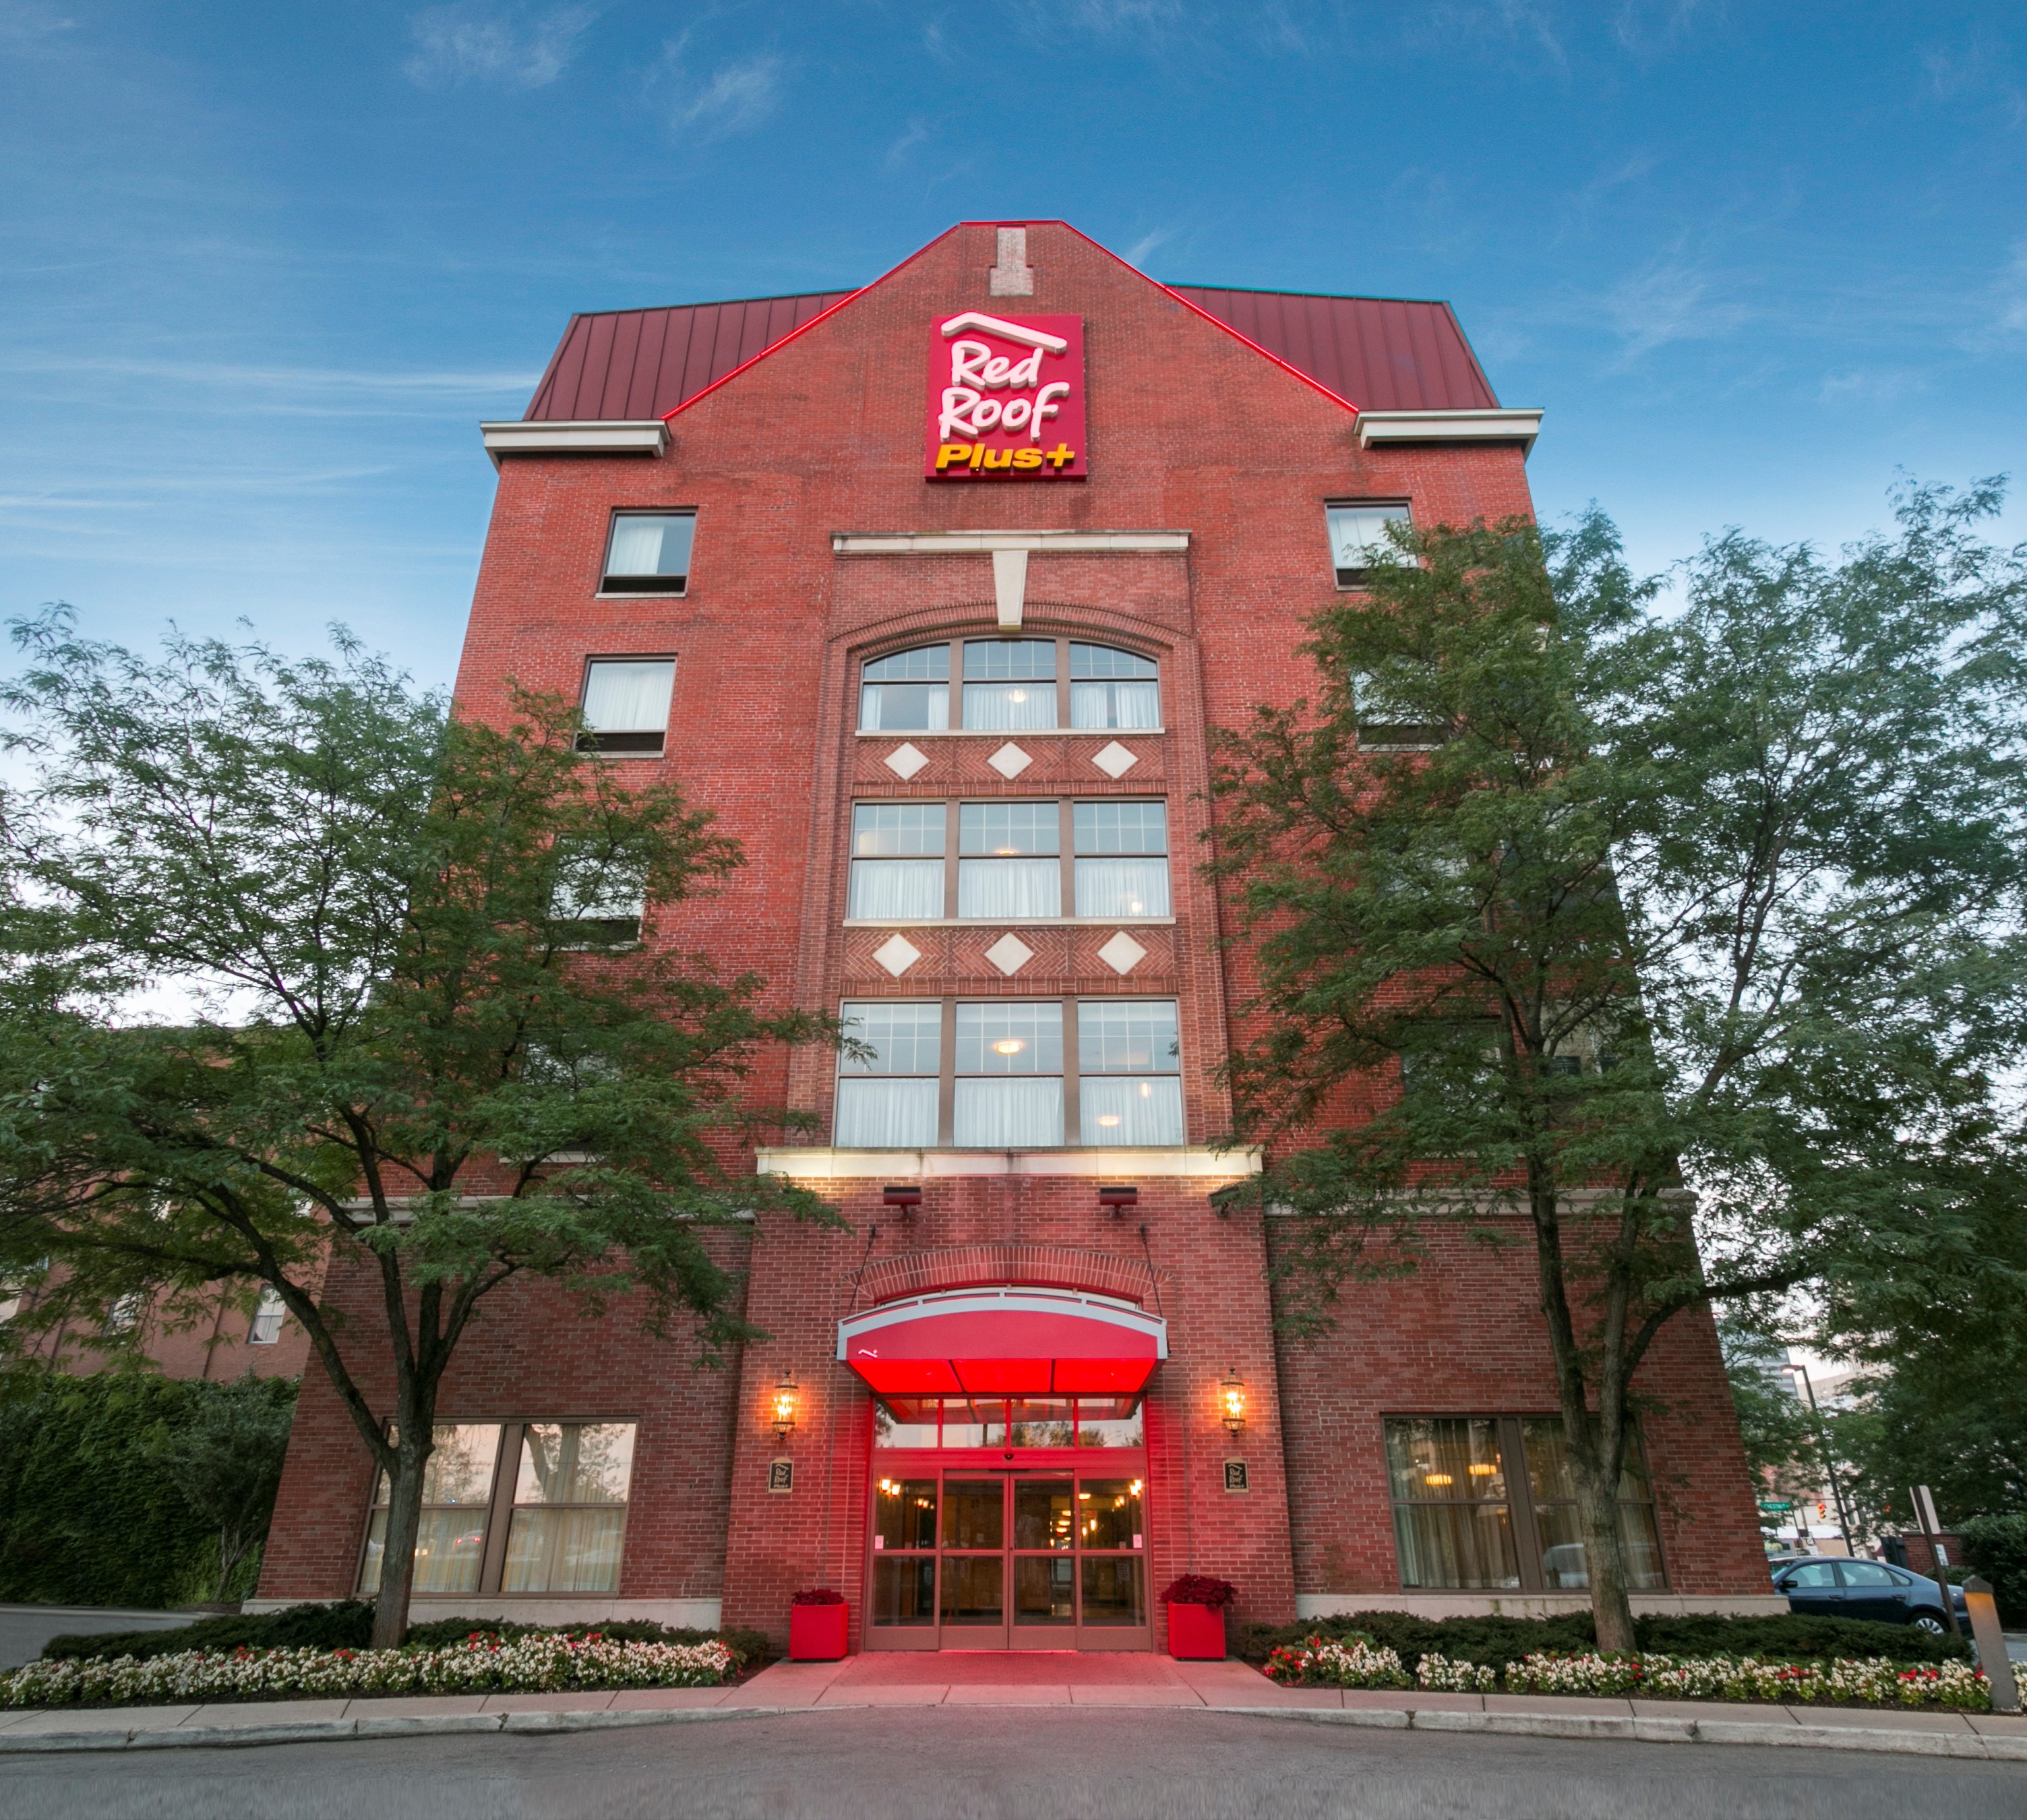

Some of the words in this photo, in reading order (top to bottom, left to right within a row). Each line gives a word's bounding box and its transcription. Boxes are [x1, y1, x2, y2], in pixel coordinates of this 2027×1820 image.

[951, 340, 1043, 391] Red
[938, 382, 1070, 442] Roof
[935, 443, 1075, 471] Plus+
[775, 1475, 788, 1484] Roof
[1230, 1475, 1243, 1484] Roof
